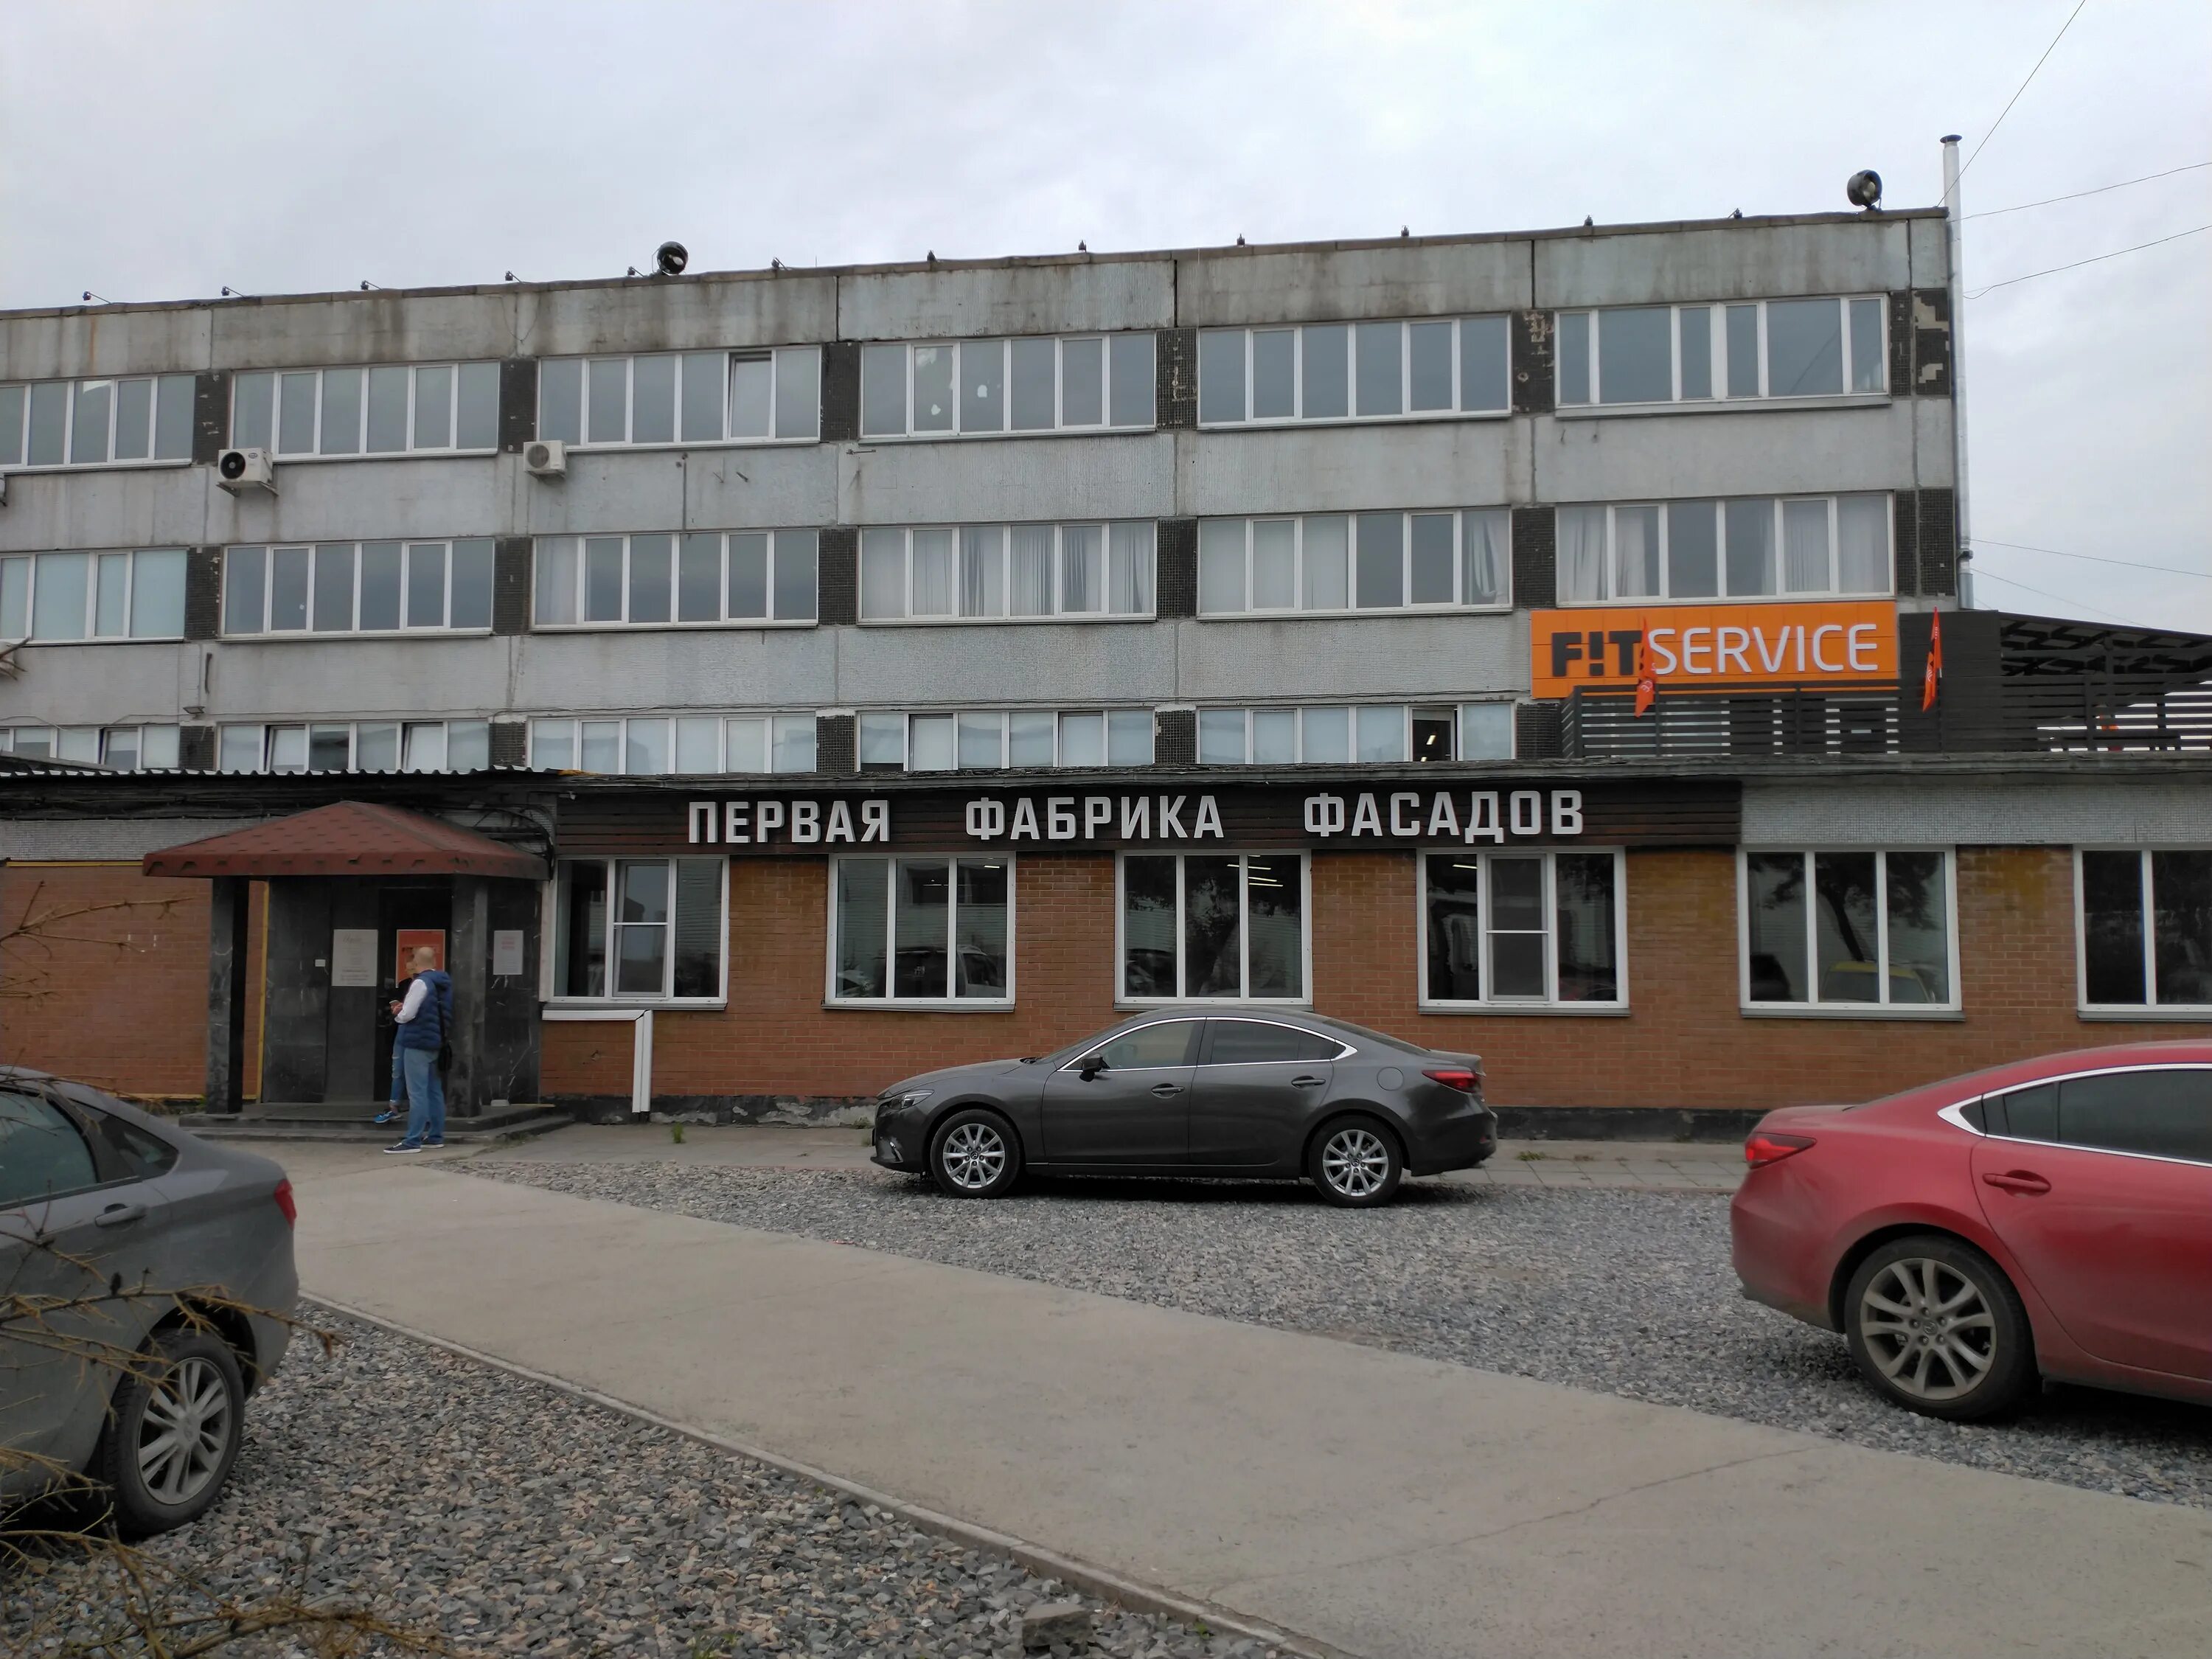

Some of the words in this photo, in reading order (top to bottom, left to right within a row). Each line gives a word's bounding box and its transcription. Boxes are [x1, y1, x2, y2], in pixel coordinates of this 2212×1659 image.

[1647, 624, 1879, 675] SERVICE
[688, 800, 891, 844] ПЕРВАЯ
[965, 795, 1225, 840] ФАБРИКА
[1304, 790, 1583, 844] ФАСАДОВ
